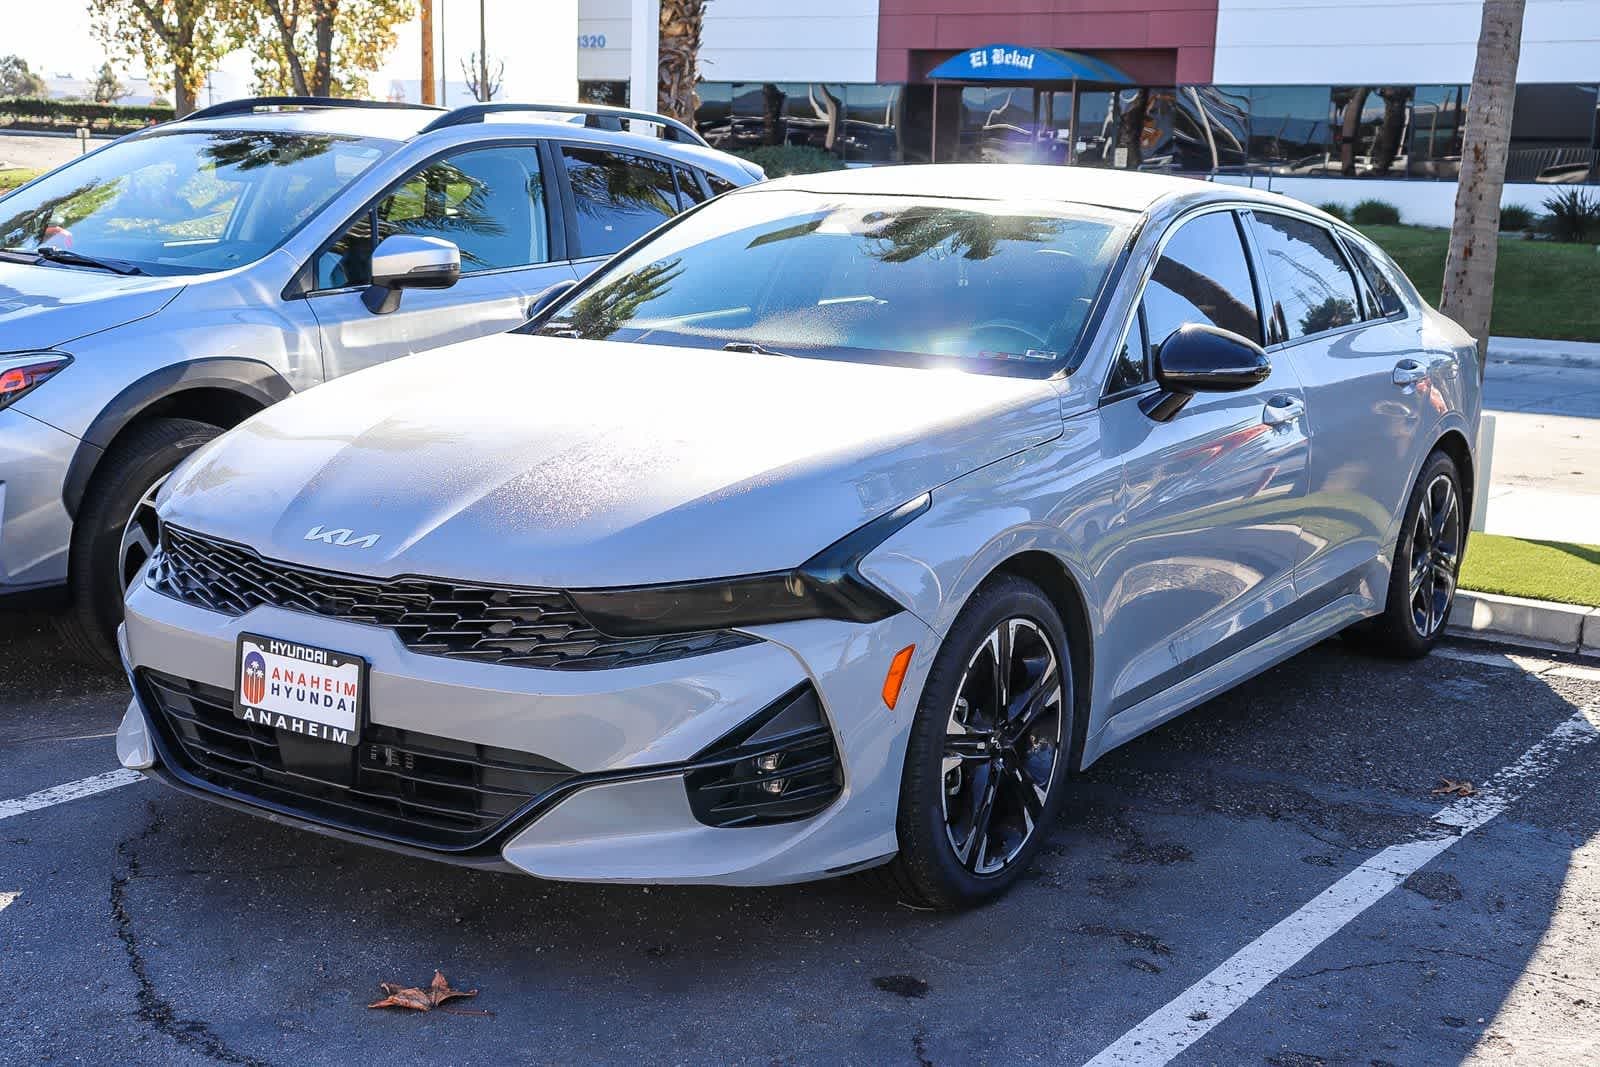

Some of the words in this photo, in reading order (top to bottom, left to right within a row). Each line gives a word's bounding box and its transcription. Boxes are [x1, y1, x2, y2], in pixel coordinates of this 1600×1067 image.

[969, 50, 987, 69] El
[992, 48, 1035, 70] Bekal
[303, 524, 382, 549] KIA
[270, 640, 328, 665] HYUNDAI
[271, 667, 356, 697] ANAHEIM
[271, 683, 355, 713] HYUNDAI
[243, 707, 348, 744] ANAHEIM
